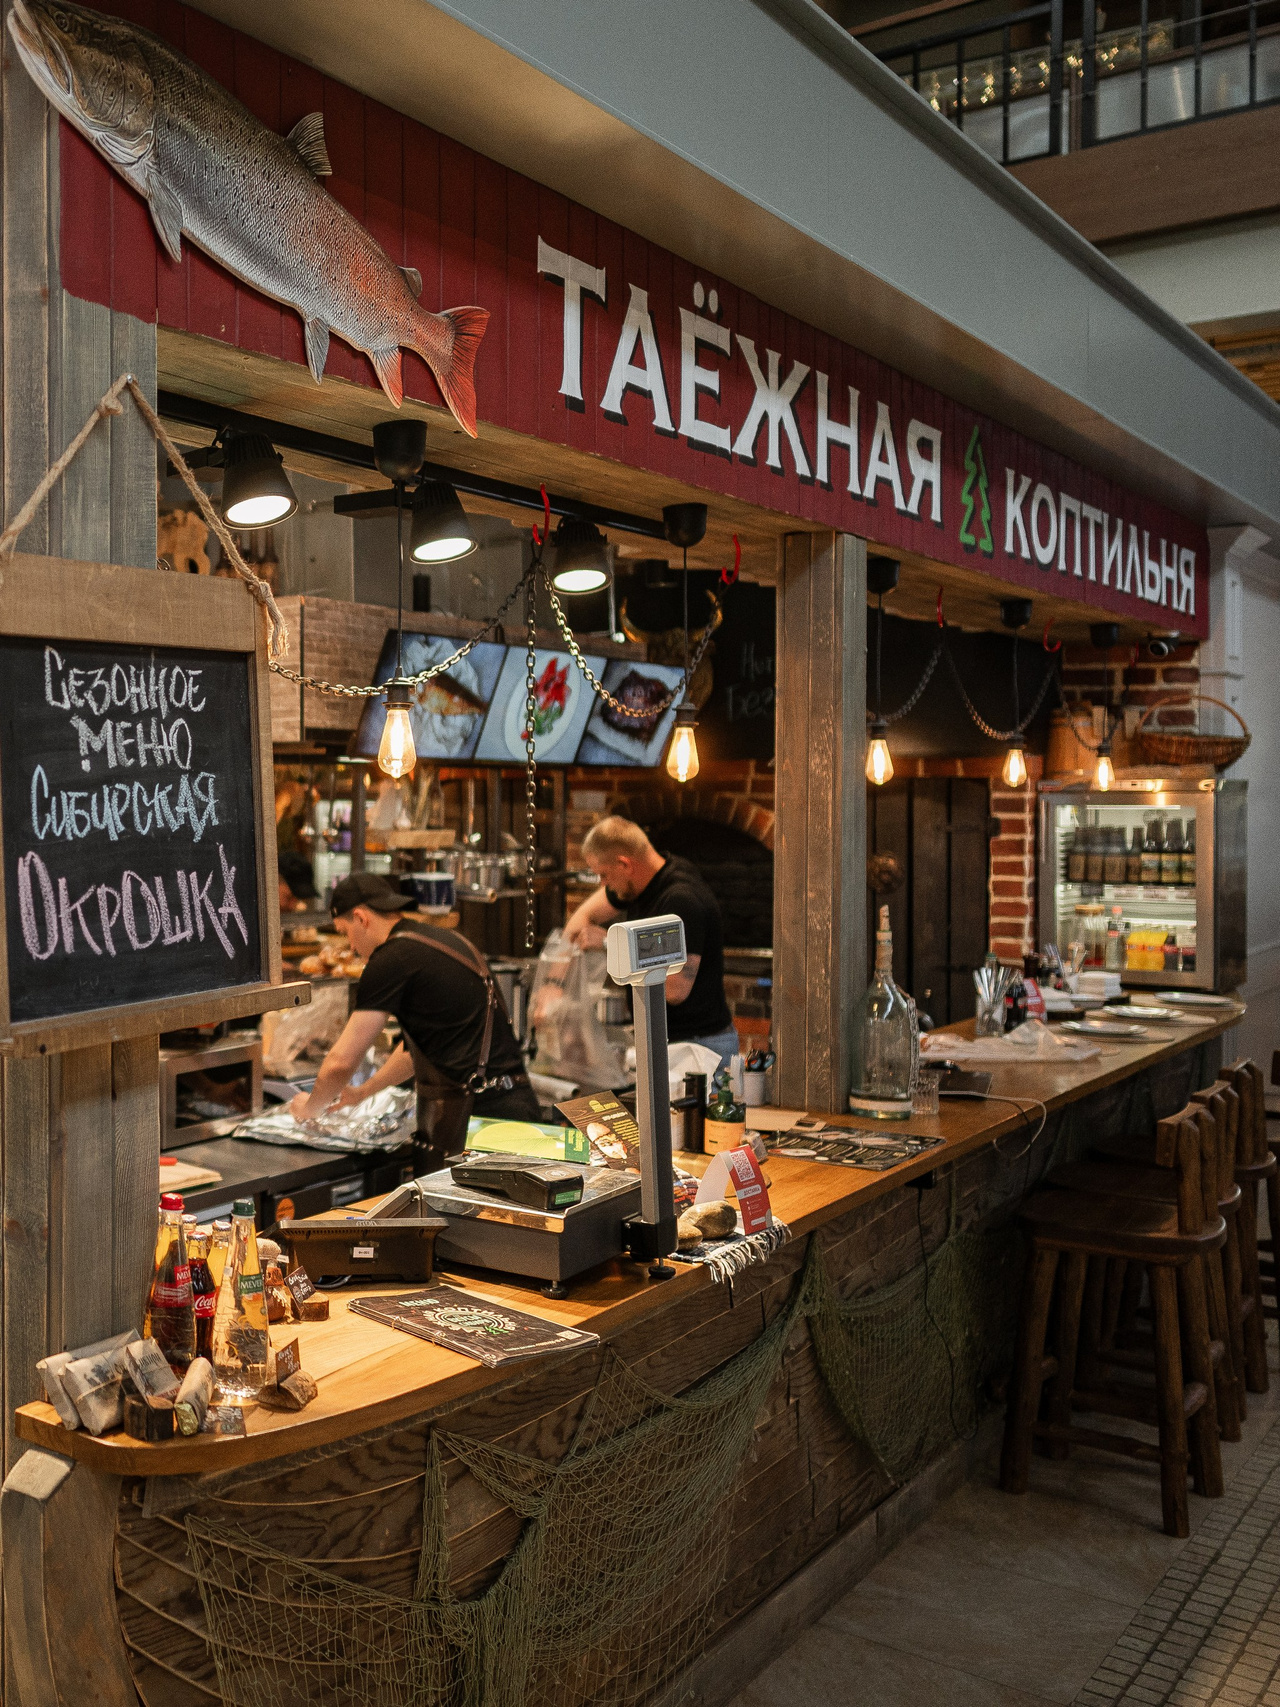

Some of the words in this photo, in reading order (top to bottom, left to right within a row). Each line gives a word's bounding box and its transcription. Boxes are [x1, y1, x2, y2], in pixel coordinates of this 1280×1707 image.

[537, 234, 943, 524] ТАЁЖНАЯ
[1005, 466, 1197, 617] КОПТИЛЬНЯ
[69, 715, 193, 773] МЕНЮ
[17, 843, 249, 961] ОКРОШКА
